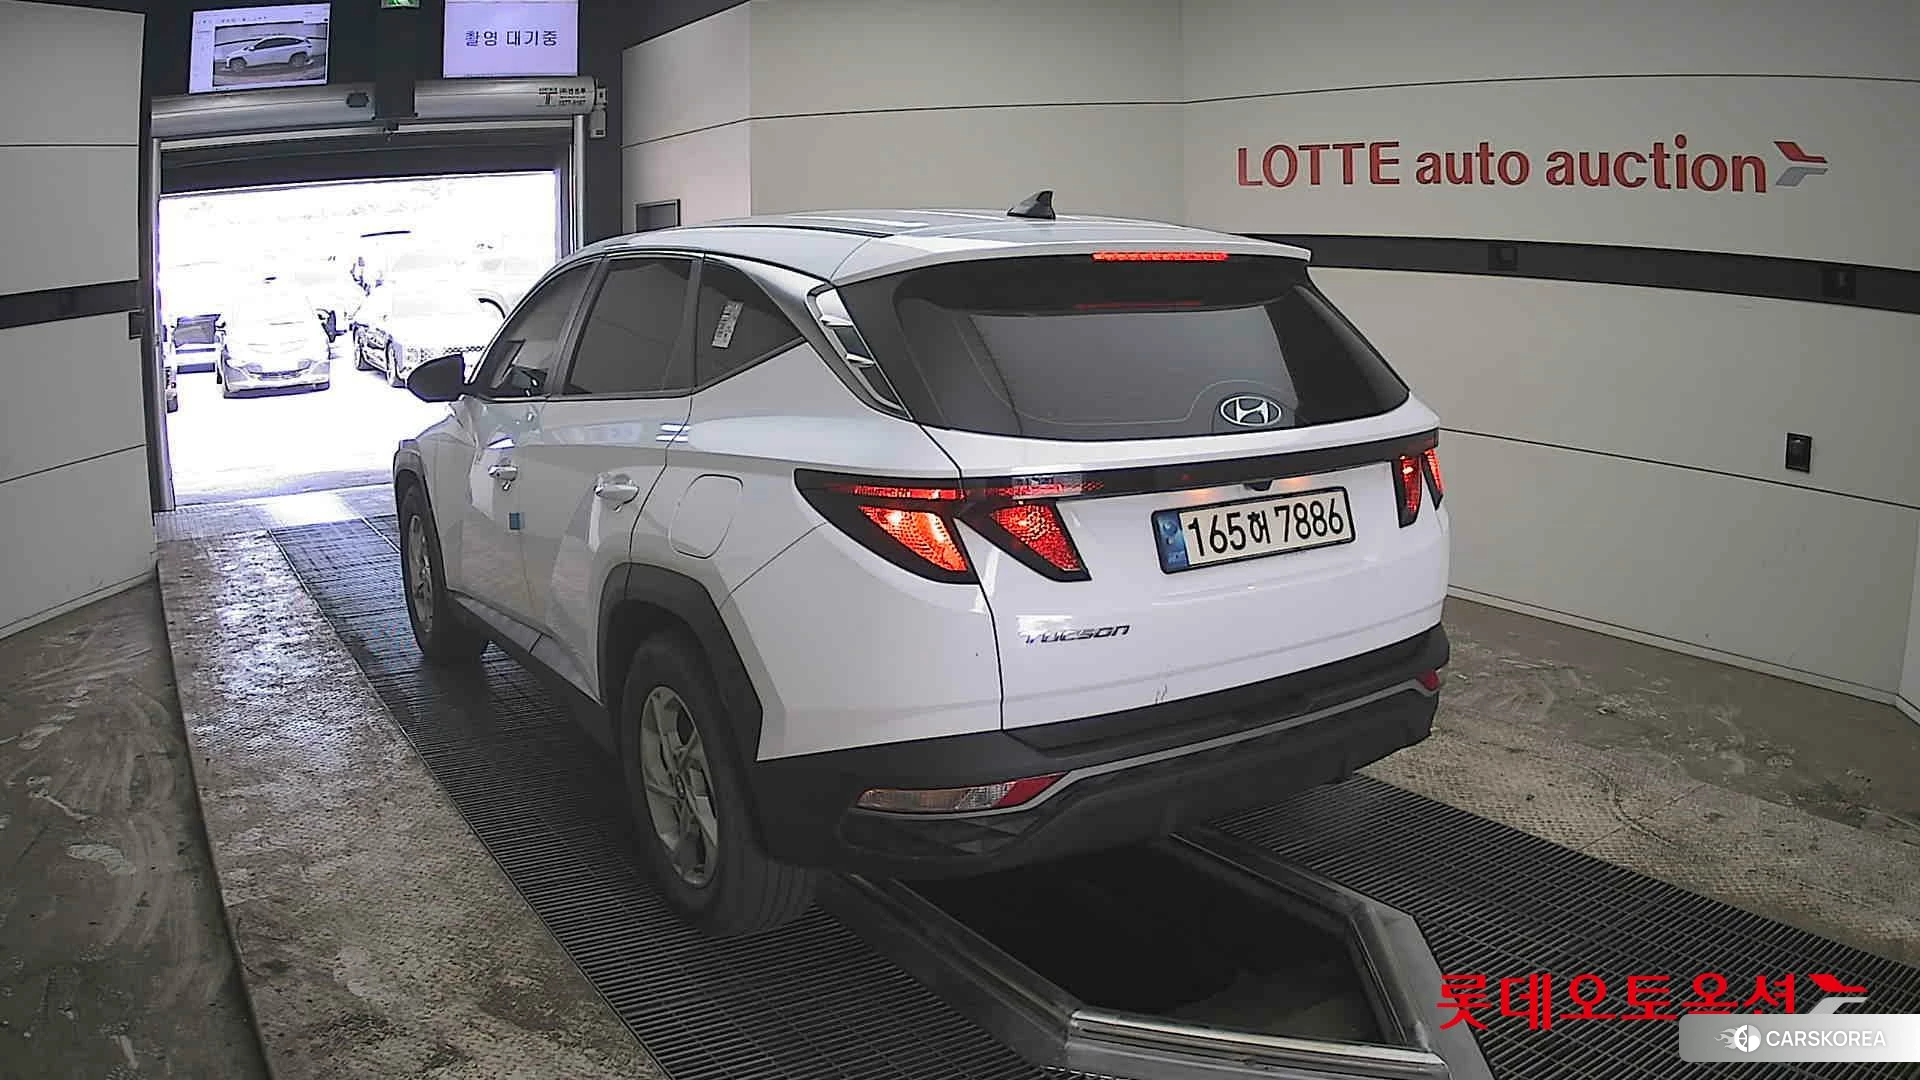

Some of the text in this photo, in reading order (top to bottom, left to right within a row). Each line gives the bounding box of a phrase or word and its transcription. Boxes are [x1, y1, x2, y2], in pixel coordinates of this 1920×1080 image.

[465, 30, 558, 47] 촬영 대기중
[1236, 133, 1767, 194] LOTTE auto auction
[1187, 497, 1345, 557] 165허 7886
